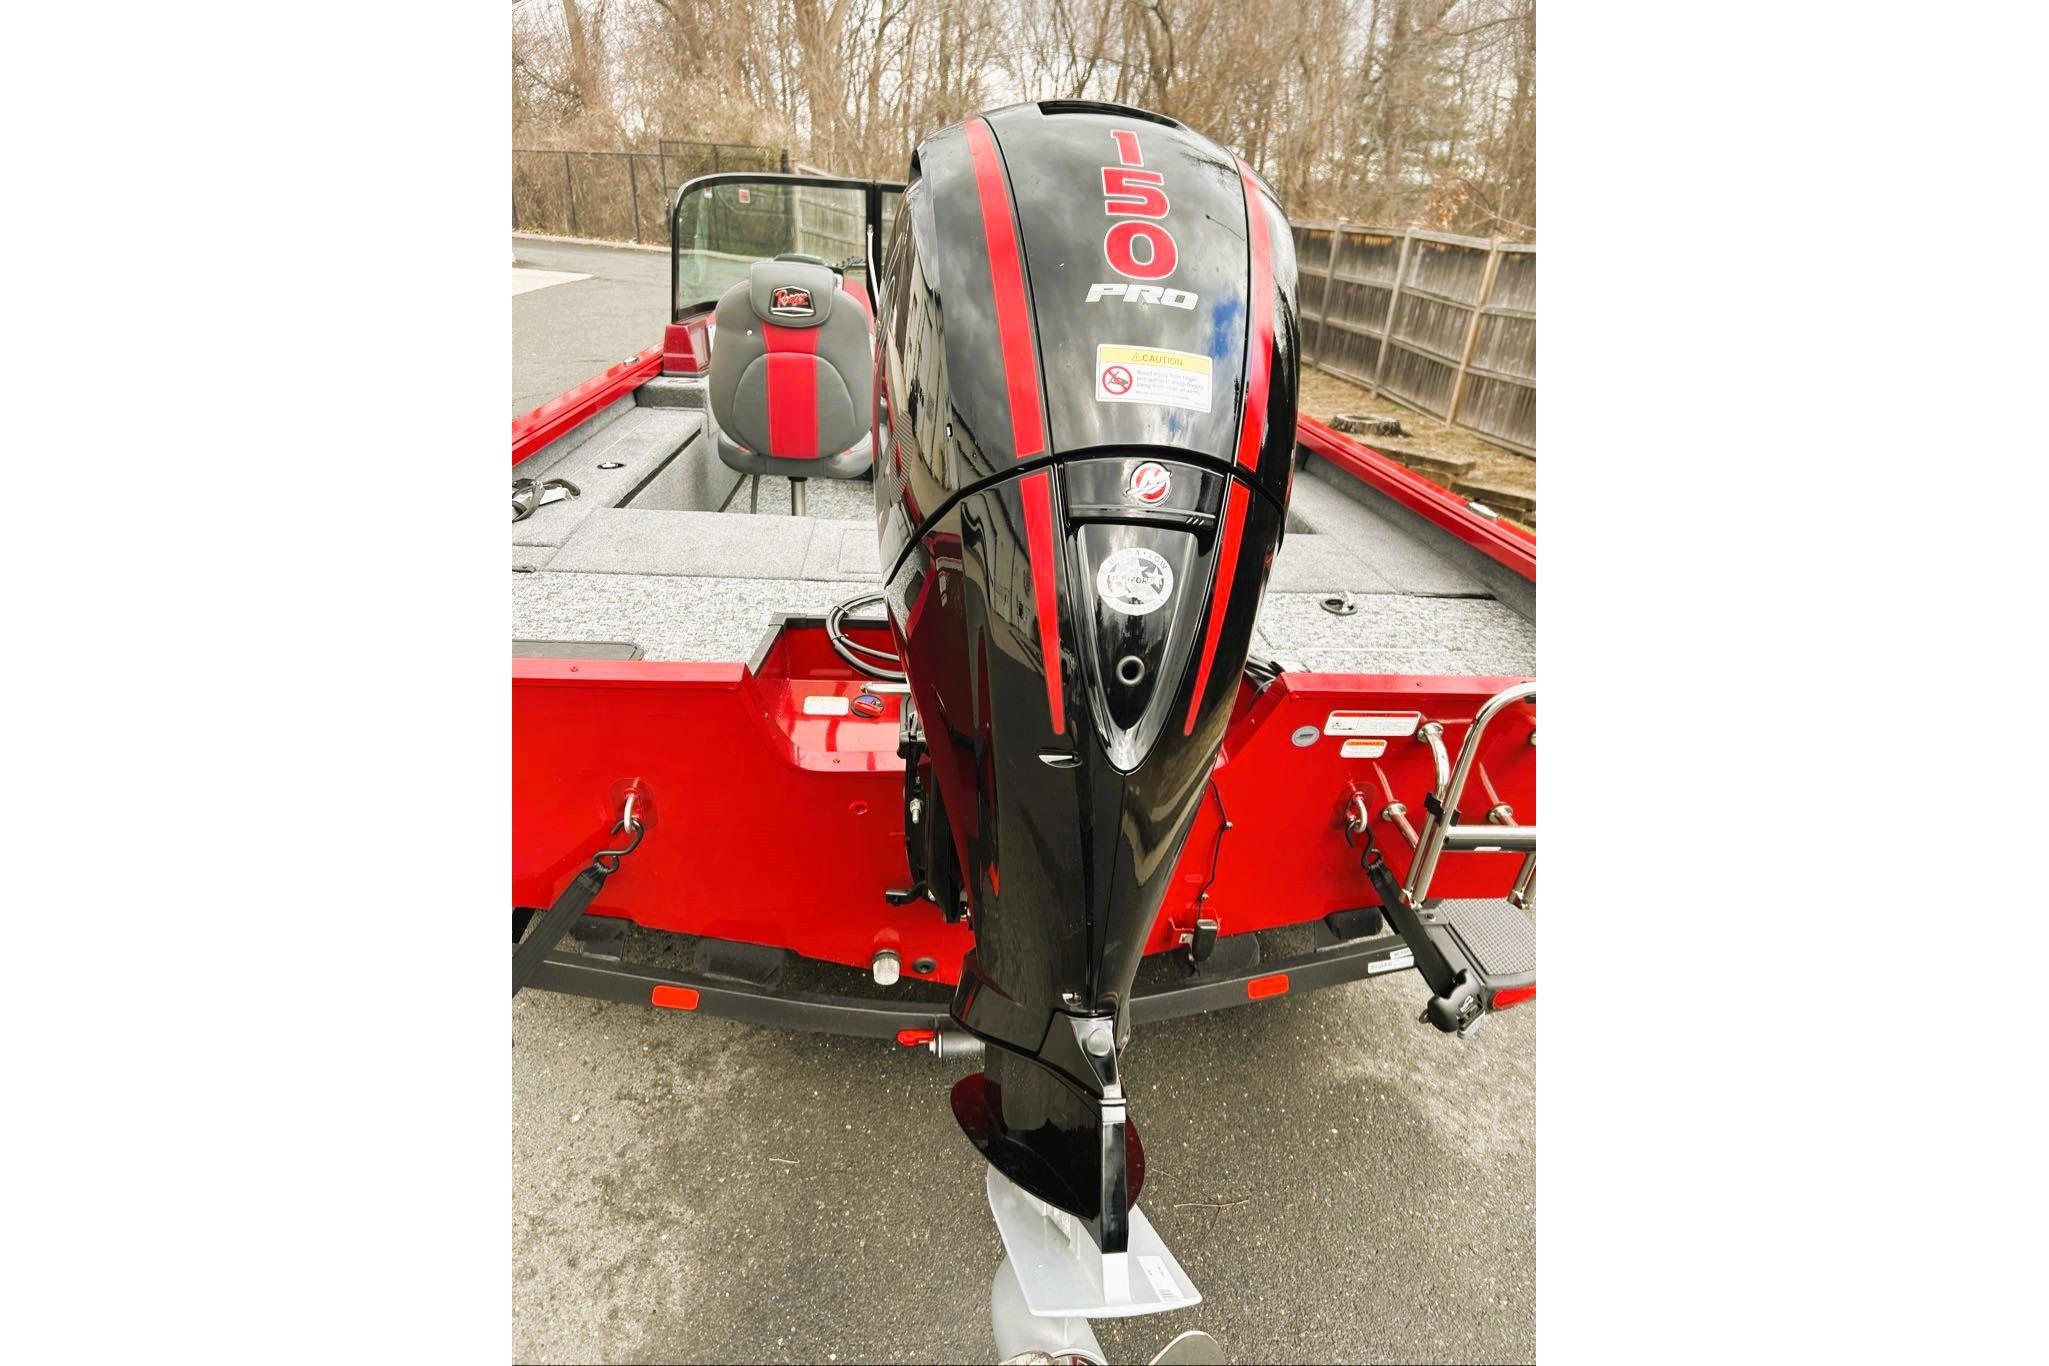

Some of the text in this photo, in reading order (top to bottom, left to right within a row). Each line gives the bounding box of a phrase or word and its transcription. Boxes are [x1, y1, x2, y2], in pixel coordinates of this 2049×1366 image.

[1101, 129, 1178, 280] 150
[1085, 283, 1199, 311] PRO
[1142, 353, 1184, 367] CAUTION
